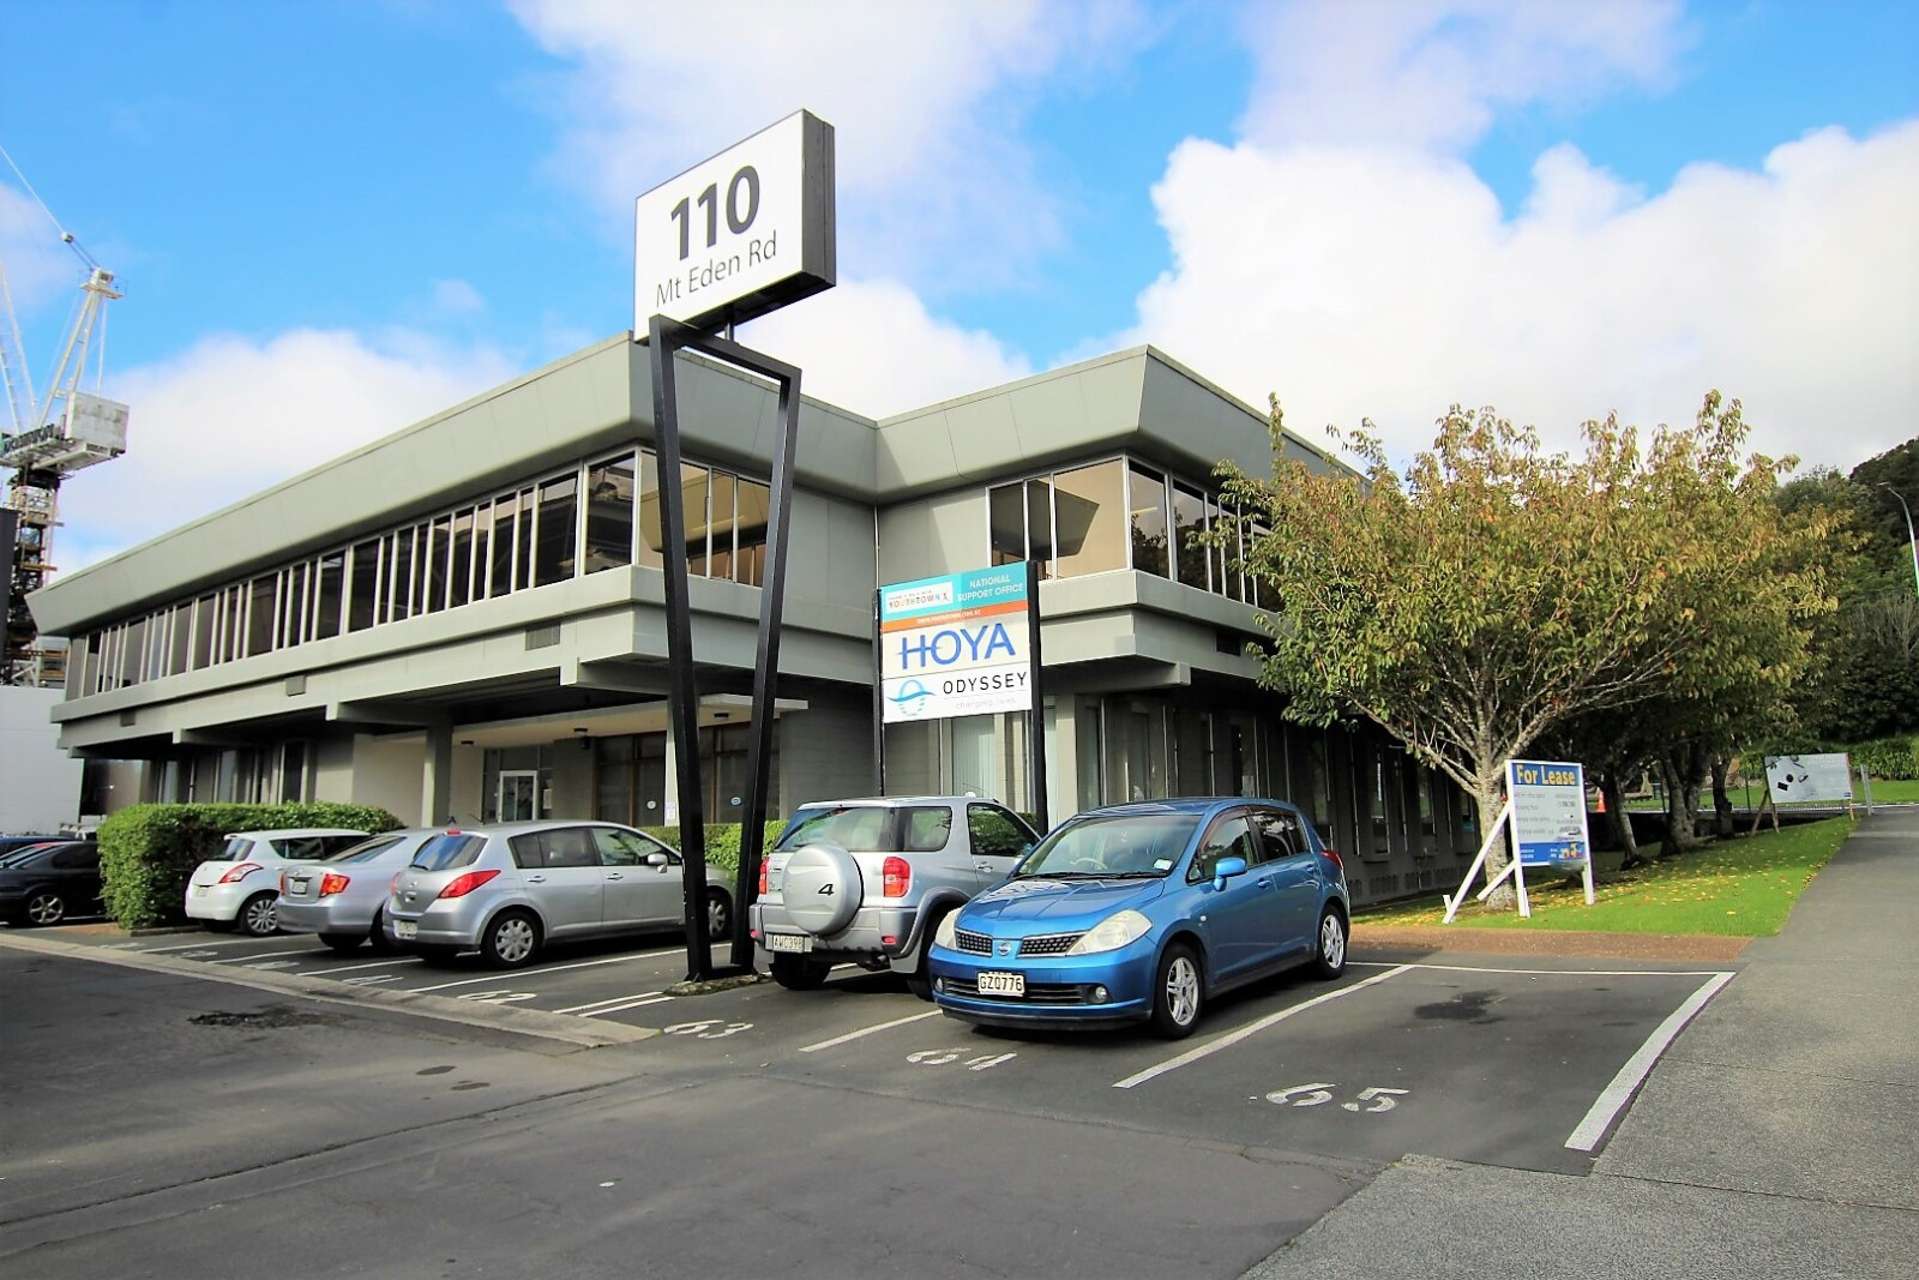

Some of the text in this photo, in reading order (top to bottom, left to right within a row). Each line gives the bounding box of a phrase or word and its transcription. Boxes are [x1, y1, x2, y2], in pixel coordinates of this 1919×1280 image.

[670, 165, 761, 261] 110
[656, 229, 777, 308] Mt Eden Rd
[957, 582, 1024, 602] SUPPORT OFFICE
[969, 573, 1010, 589] NATIONAL
[901, 622, 1016, 670] HOYA
[943, 671, 1027, 695] ODYSSEY
[1516, 764, 1576, 786] For Lease
[818, 883, 834, 896] 4
